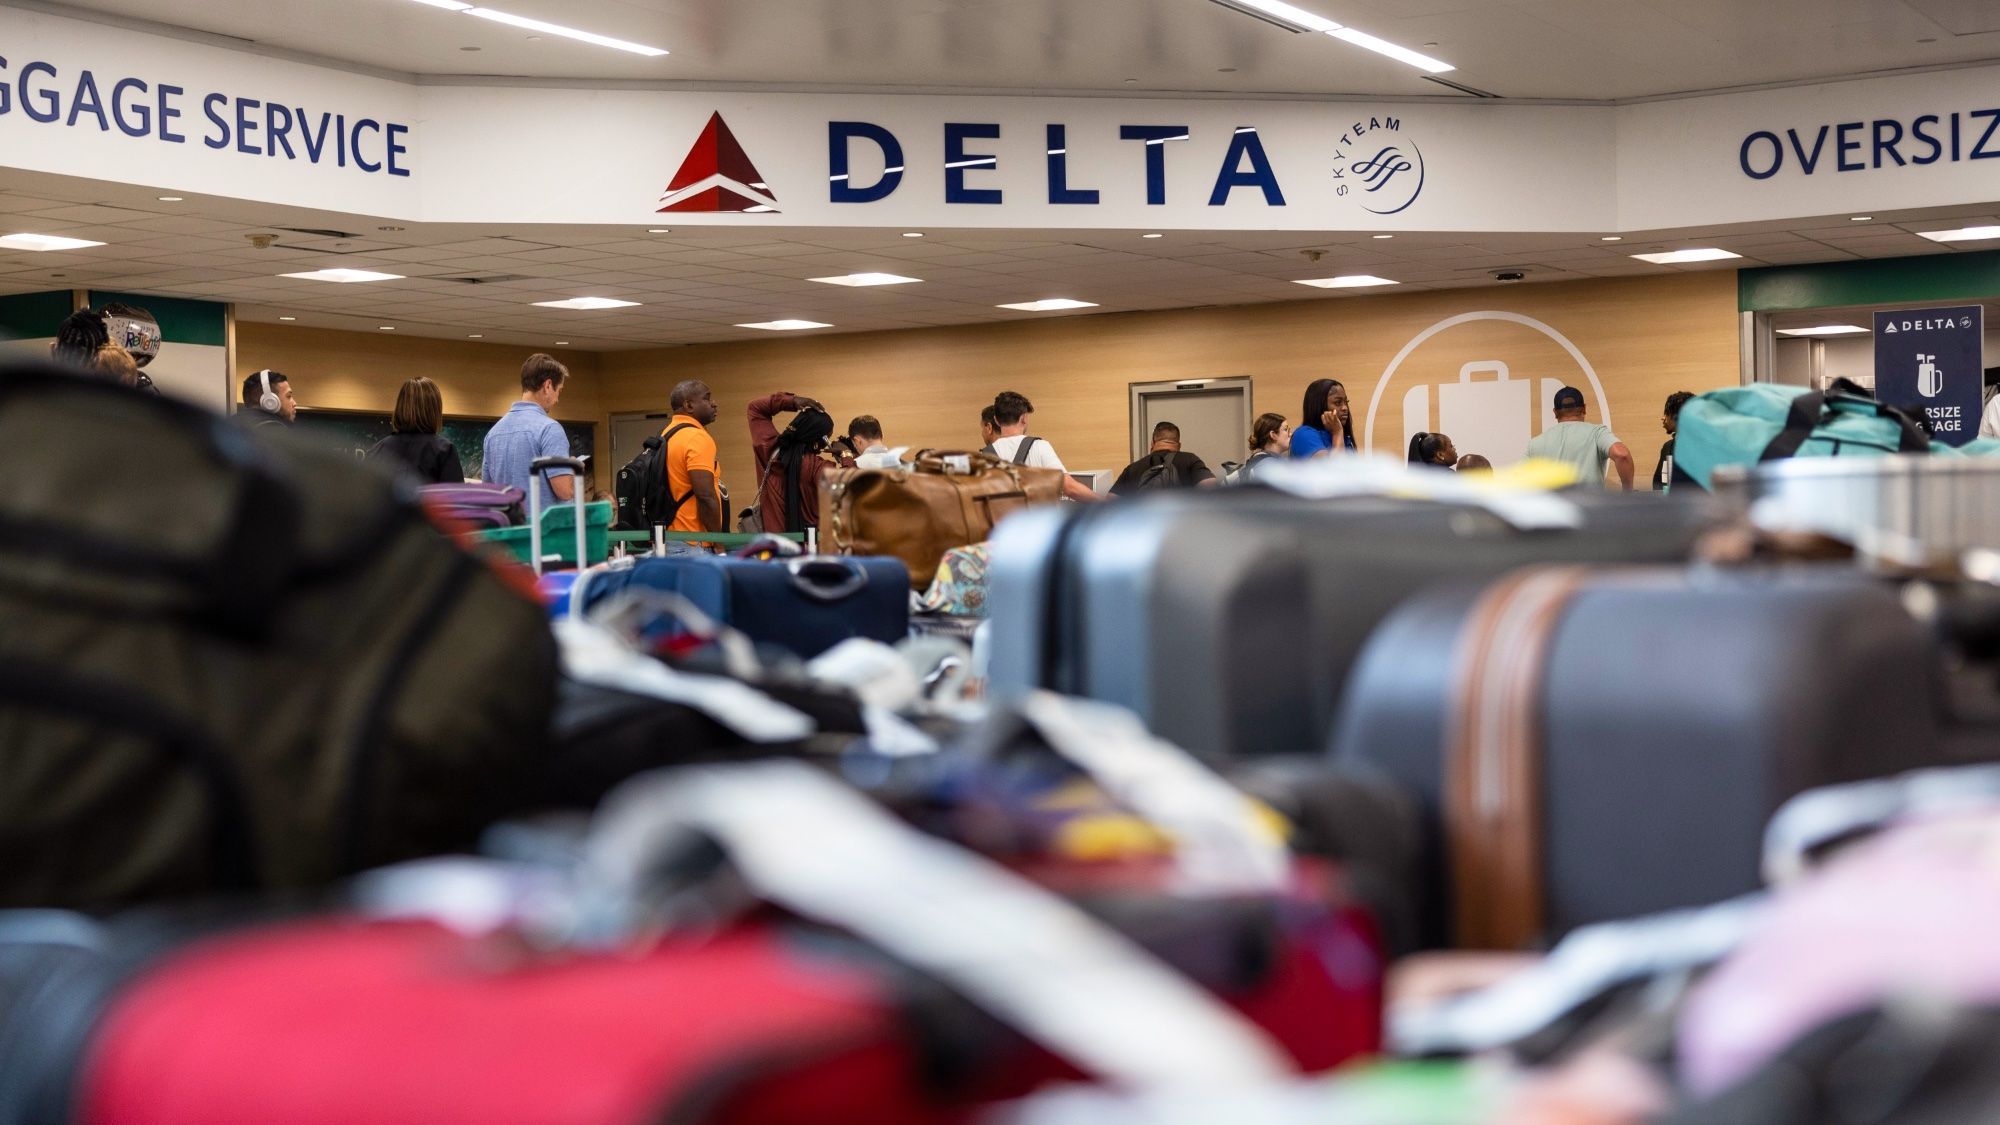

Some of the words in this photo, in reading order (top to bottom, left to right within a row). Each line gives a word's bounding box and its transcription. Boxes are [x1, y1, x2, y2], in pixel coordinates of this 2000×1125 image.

[0, 56, 186, 143] GAGE
[203, 93, 411, 177] SERVICE
[1332, 116, 1401, 197] SKYTEAM
[829, 121, 1287, 206] DELTA
[1902, 318, 1956, 332] DELTA
